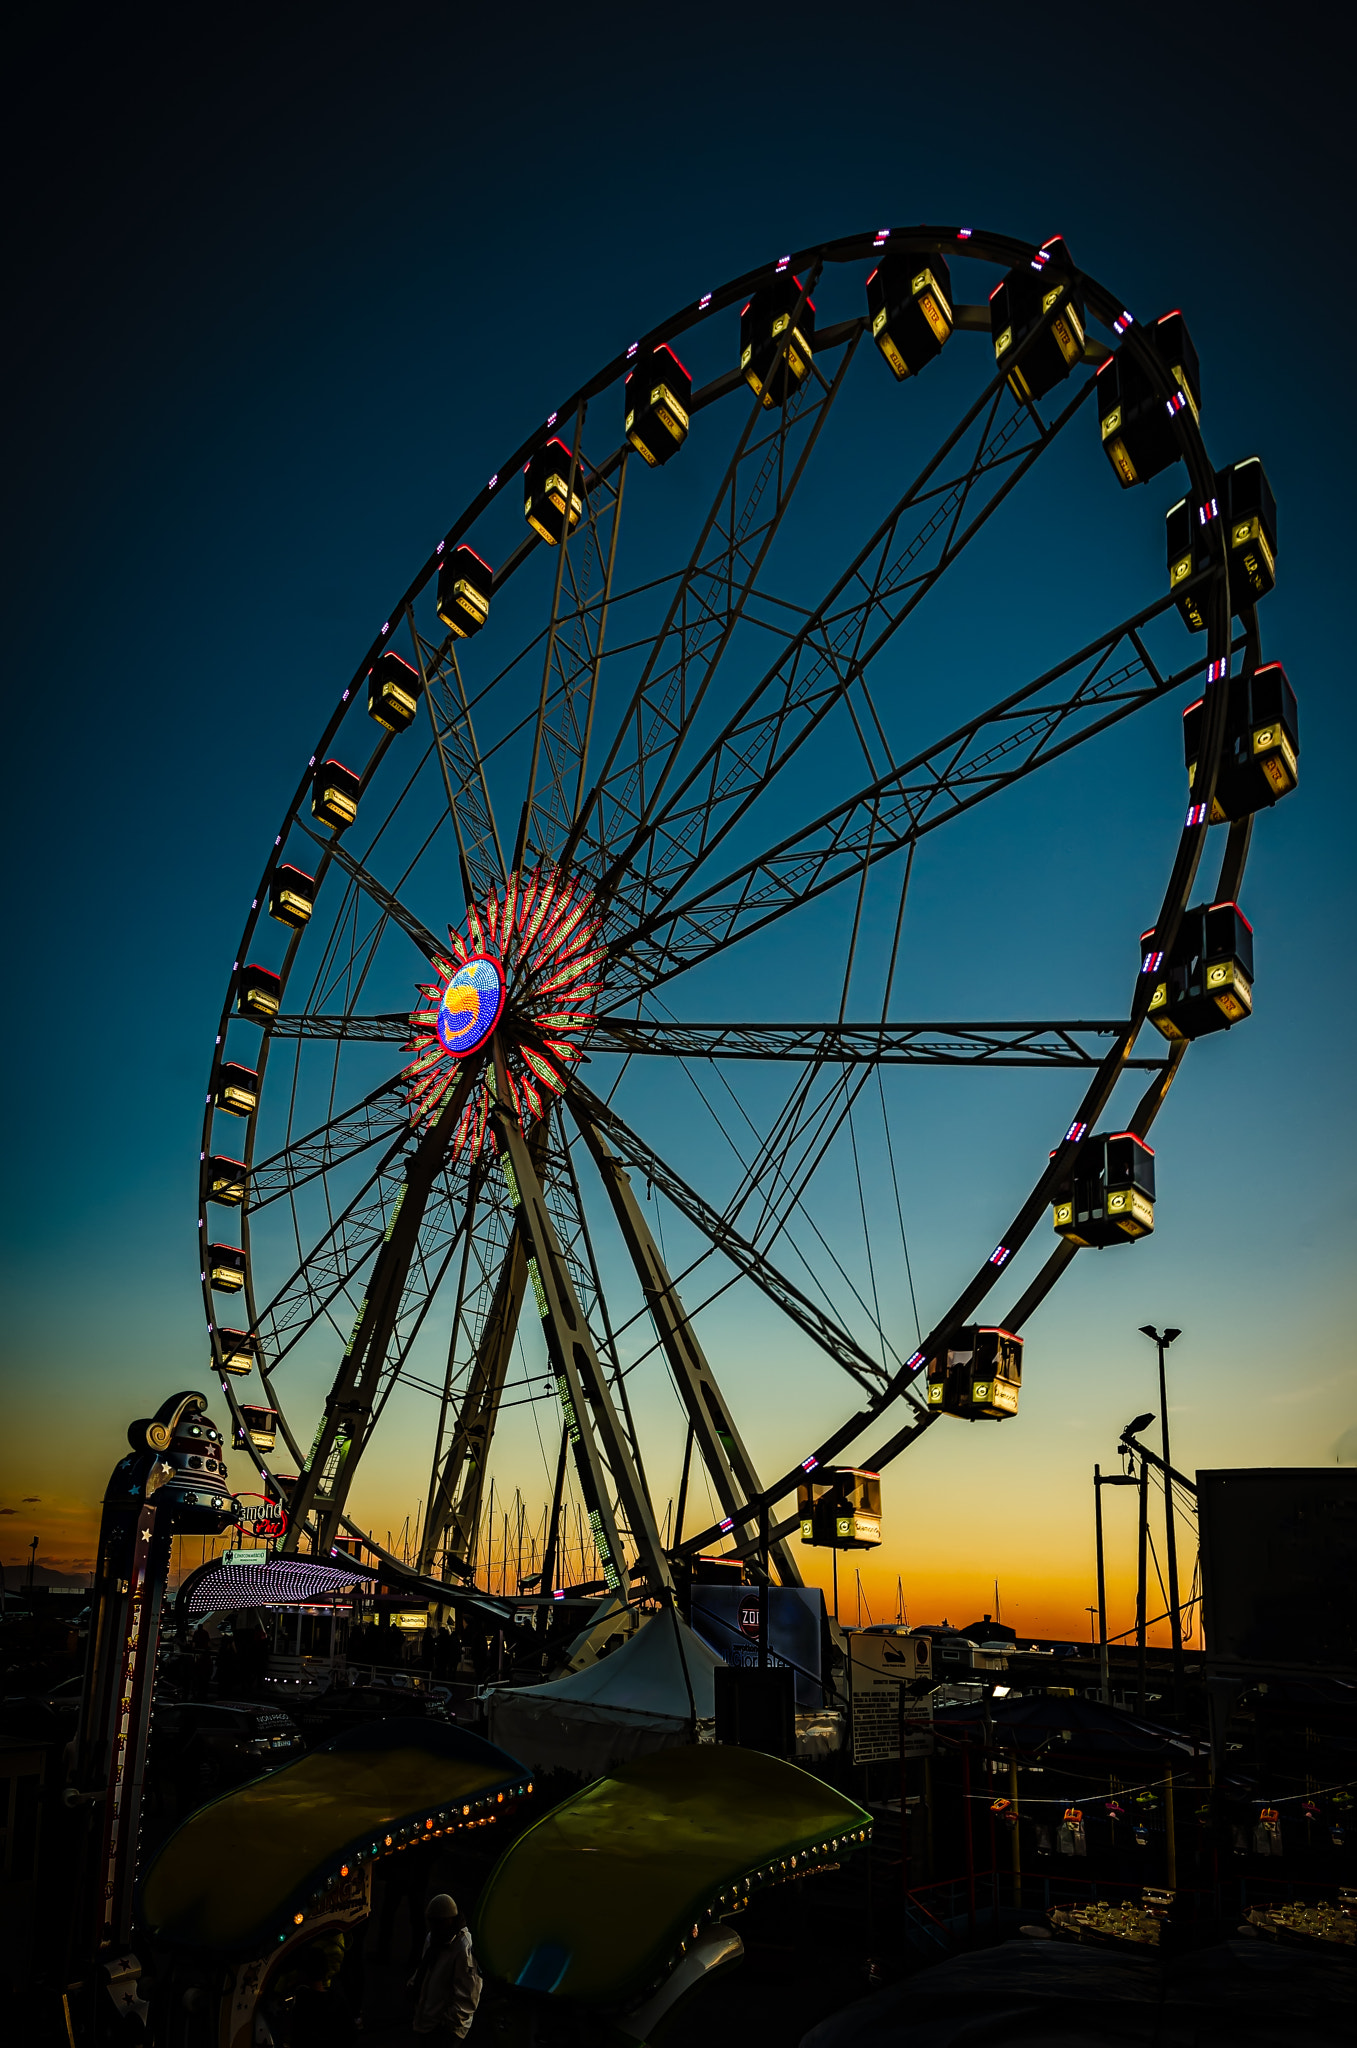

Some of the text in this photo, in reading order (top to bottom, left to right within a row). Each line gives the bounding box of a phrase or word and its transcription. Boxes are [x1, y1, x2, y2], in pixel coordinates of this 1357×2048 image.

[922, 296, 941, 324] CENTER
[1056, 319, 1071, 345] CENTER
[889, 352, 907, 376] CENTER
[658, 408, 676, 428] CENTER
[640, 445, 656, 465] CENTER
[1119, 459, 1134, 481] CENTER
[239, 1498, 283, 1521] amond
[742, 1610, 760, 1624] ZO
